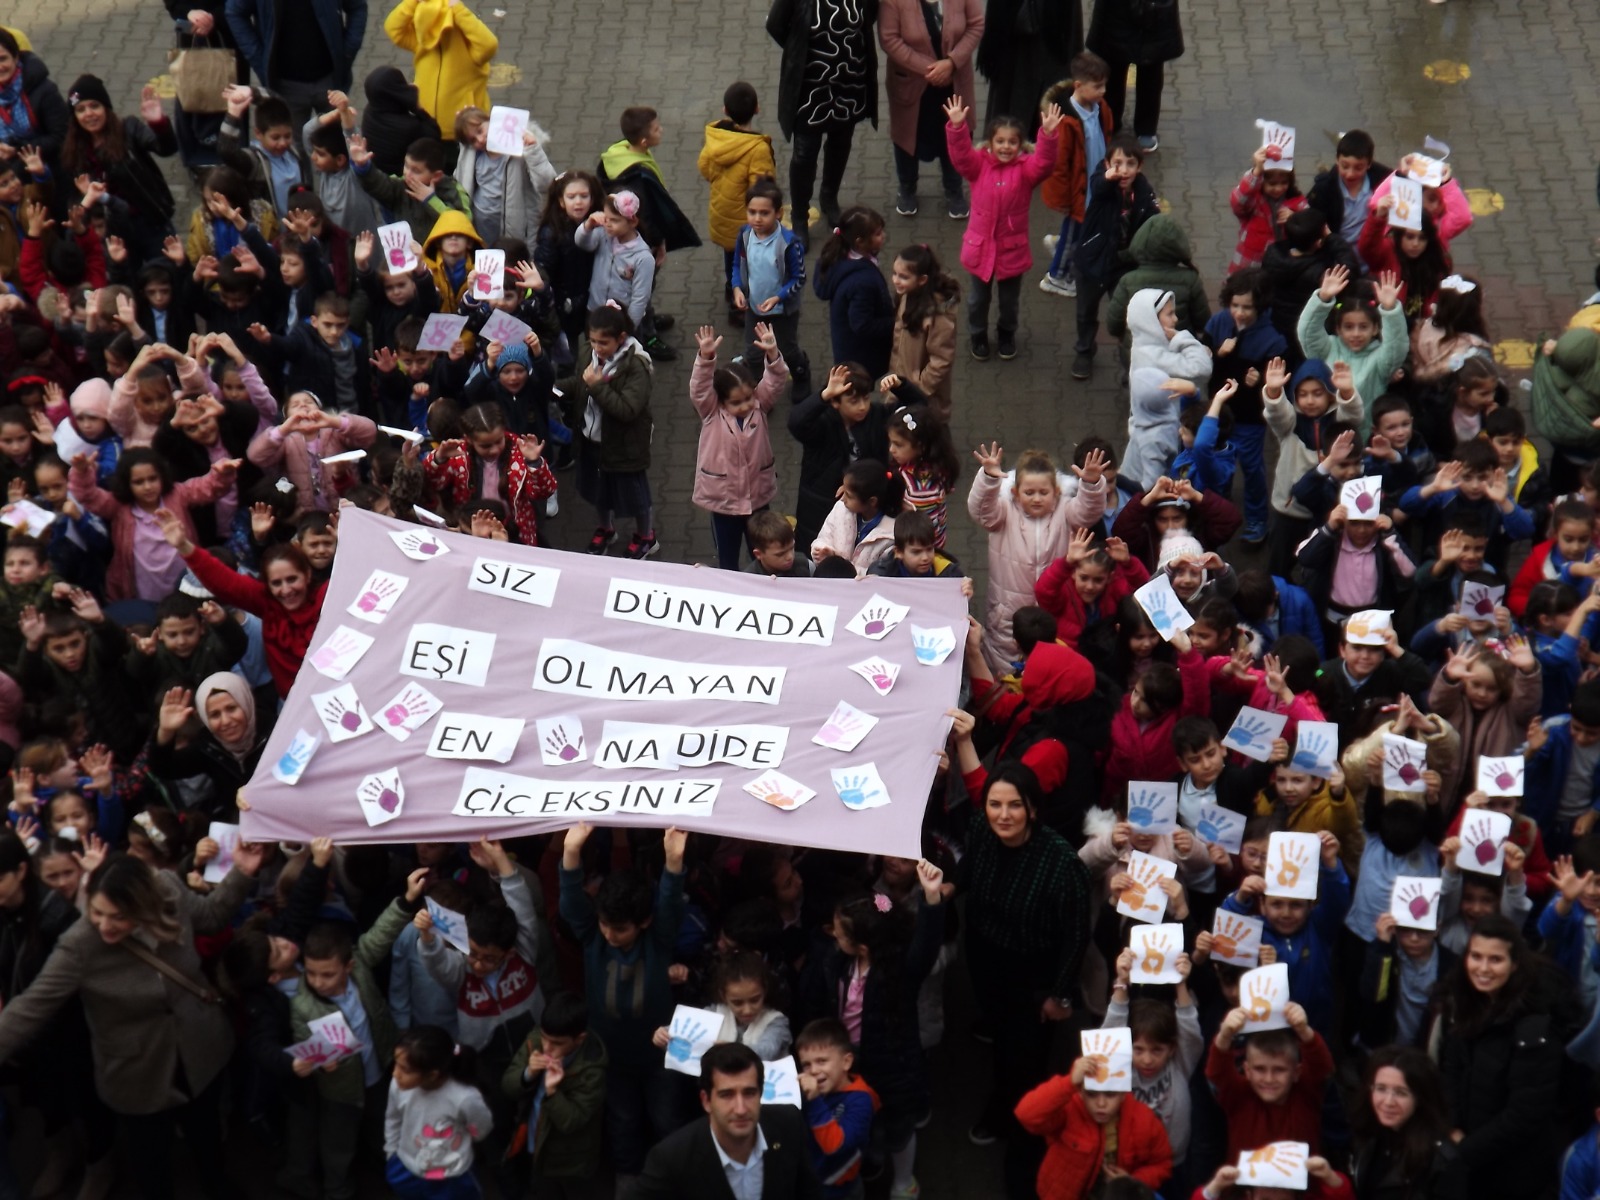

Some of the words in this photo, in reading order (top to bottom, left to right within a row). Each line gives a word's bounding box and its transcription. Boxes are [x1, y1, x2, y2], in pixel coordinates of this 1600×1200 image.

[475, 563, 536, 596] SİZ
[612, 589, 825, 639] DÜNYADA
[409, 639, 470, 679] EŞİ
[541, 654, 776, 697] OLMAYAN
[436, 725, 493, 754] EN
